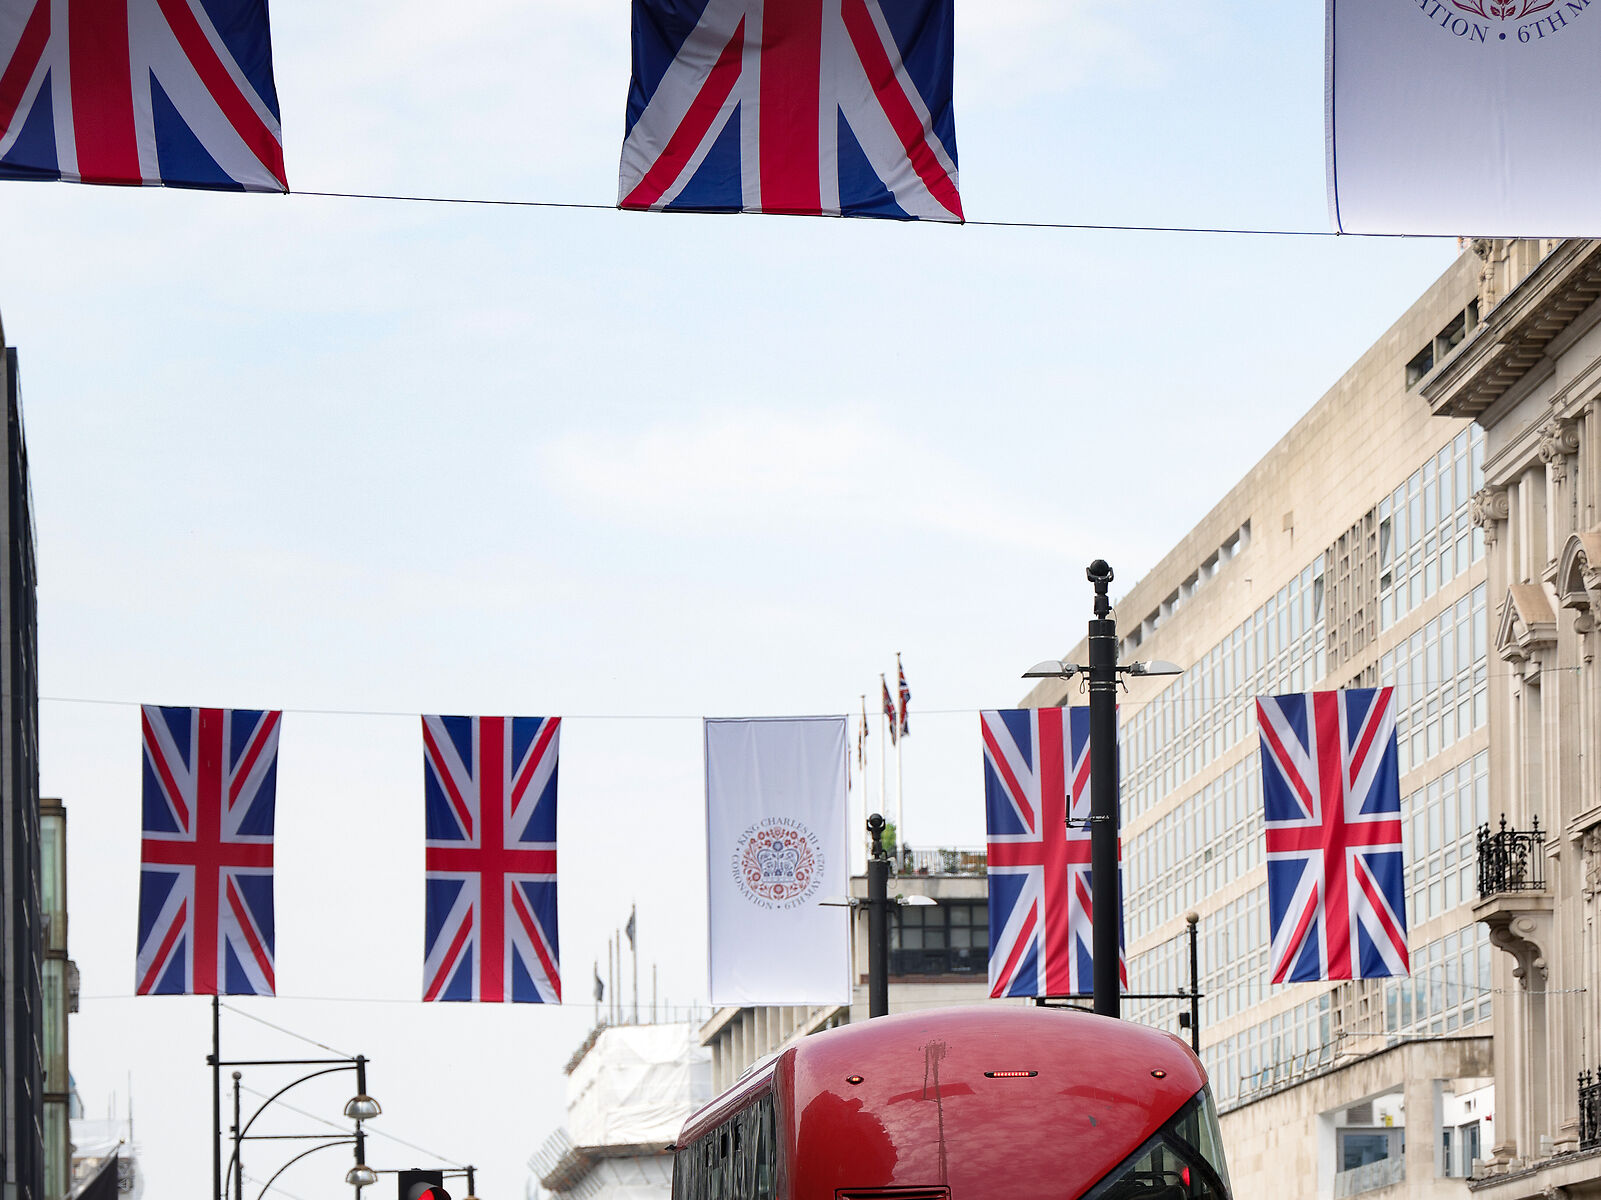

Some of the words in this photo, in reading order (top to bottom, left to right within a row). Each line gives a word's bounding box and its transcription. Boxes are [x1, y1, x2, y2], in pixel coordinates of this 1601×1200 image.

[1518, 10, 1568, 44] 6TH
[738, 824, 759, 846] KING
[760, 816, 808, 834] CHARLES
[806, 832, 819, 845] III
[731, 854, 773, 910] CORONATION
[784, 895, 806, 910] 6TH
[804, 880, 821, 899] MAY
